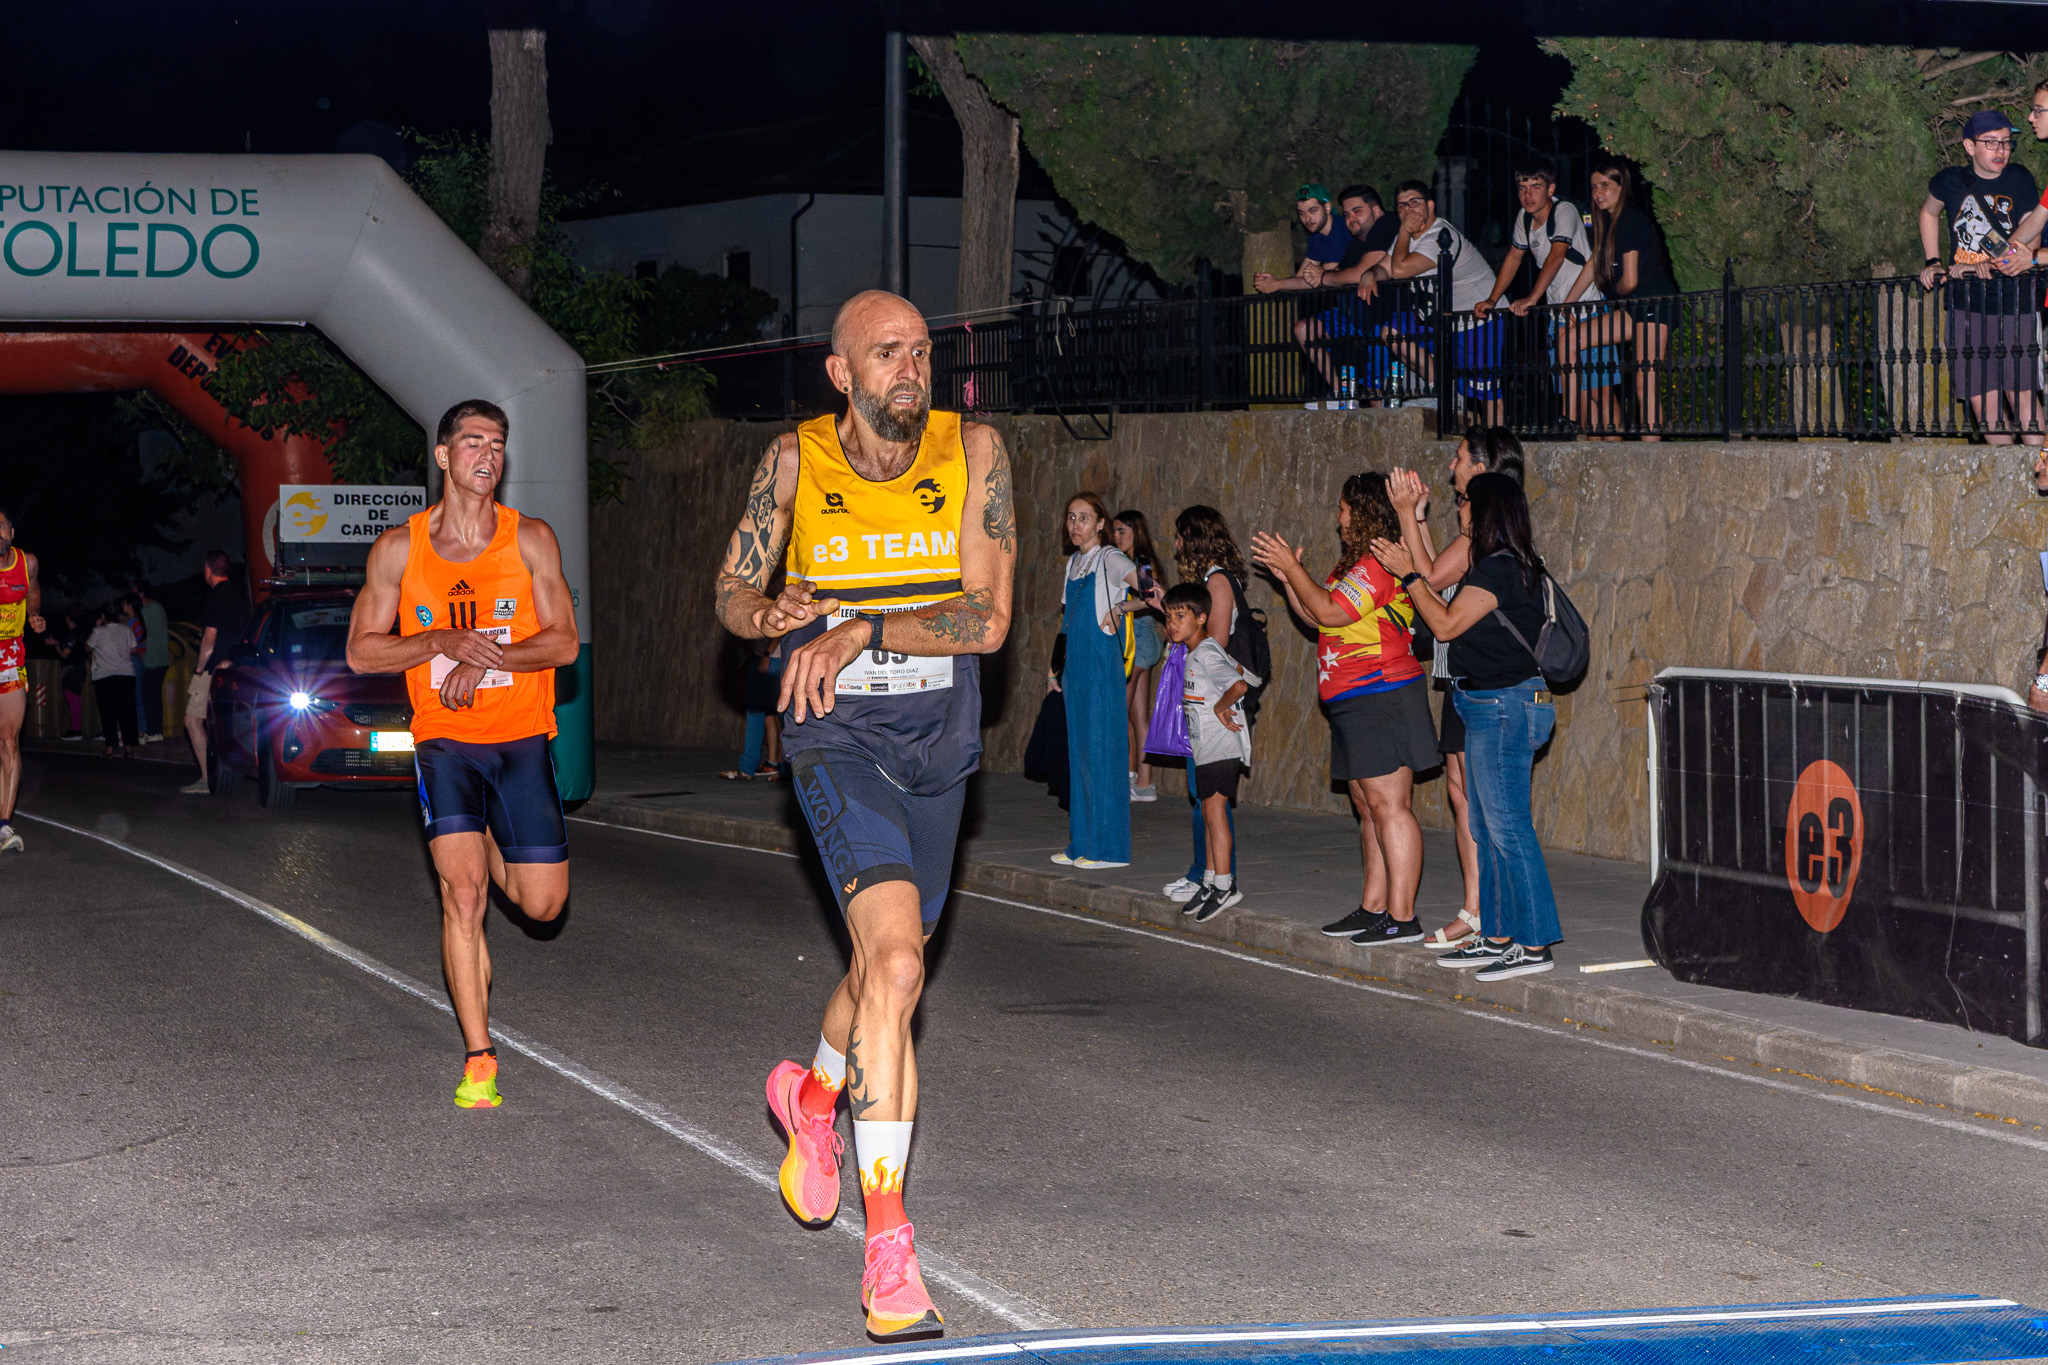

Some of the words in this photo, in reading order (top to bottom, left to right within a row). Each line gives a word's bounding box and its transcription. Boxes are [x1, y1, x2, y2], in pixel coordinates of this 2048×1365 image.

[0, 181, 196, 216] PUTACIÓN
[211, 188, 260, 216] DE
[0, 220, 260, 279] OLEDO
[334, 490, 423, 506] DIRECCIÓN
[341, 524, 401, 536] CARR
[368, 509, 389, 521] DE
[813, 535, 849, 563] e3
[861, 531, 957, 560] TEAM
[448, 588, 475, 596] adidas
[805, 778, 853, 875] WONG
[1798, 797, 1855, 899] e3
